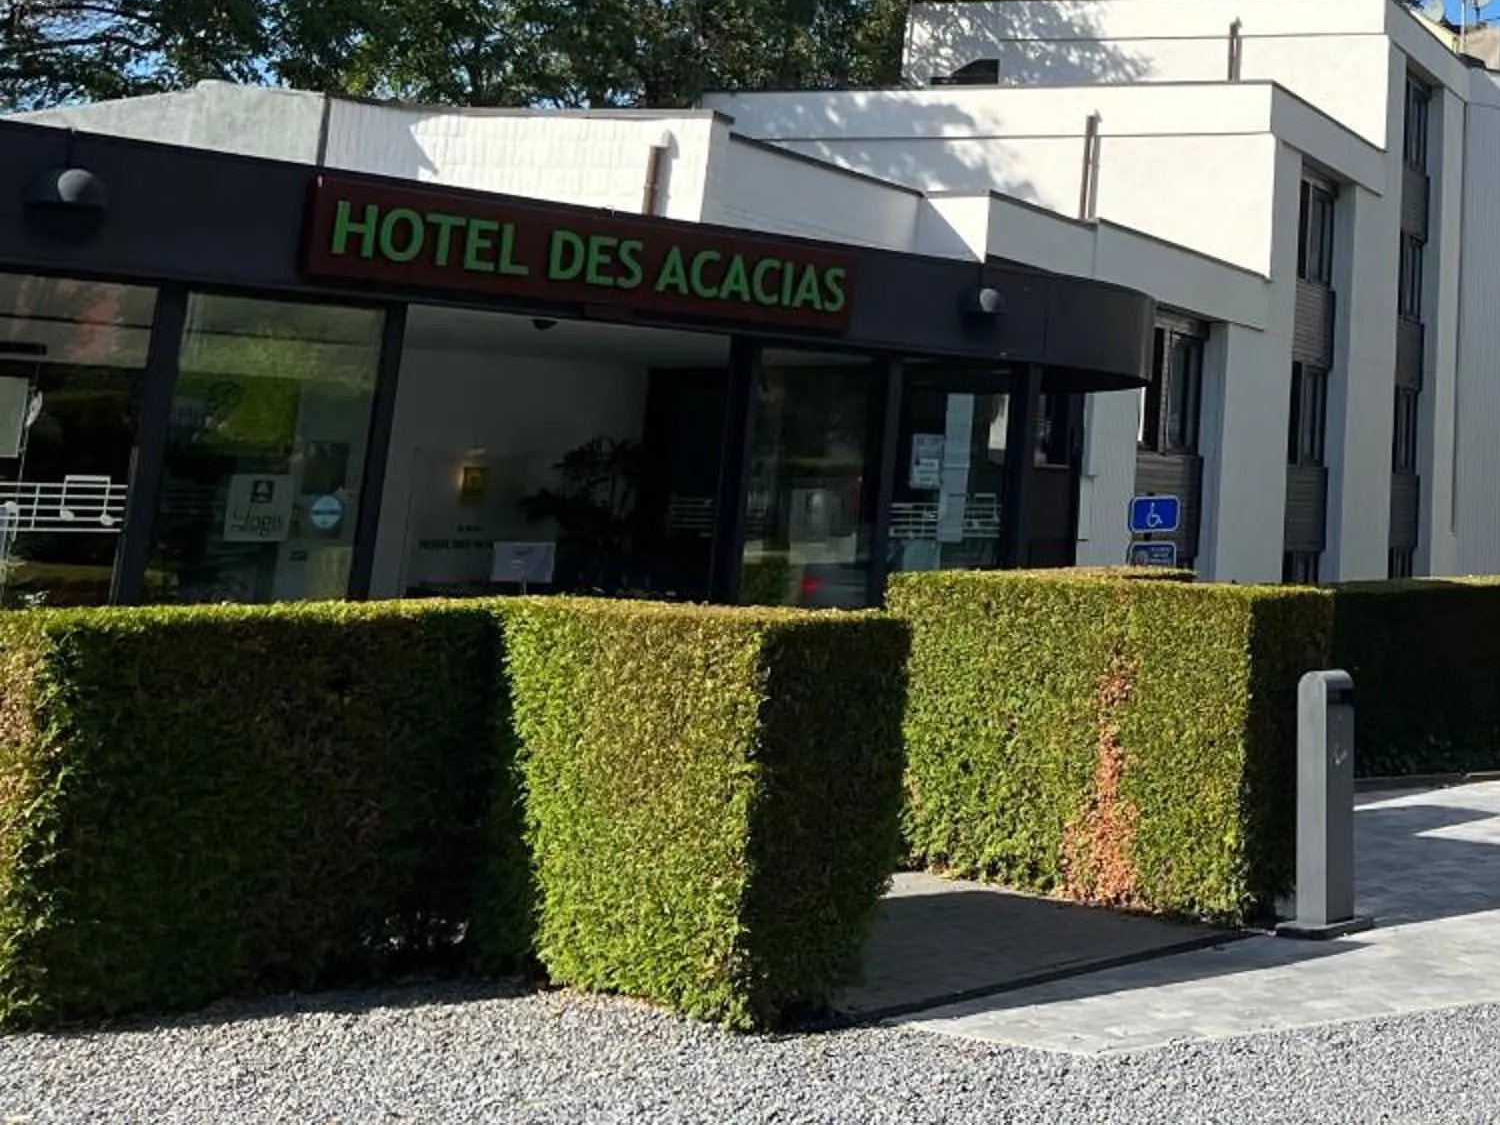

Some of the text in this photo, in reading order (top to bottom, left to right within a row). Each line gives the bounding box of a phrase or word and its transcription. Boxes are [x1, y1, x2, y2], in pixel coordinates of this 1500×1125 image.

[331, 200, 846, 312] HOTEL DES ACACIAS
